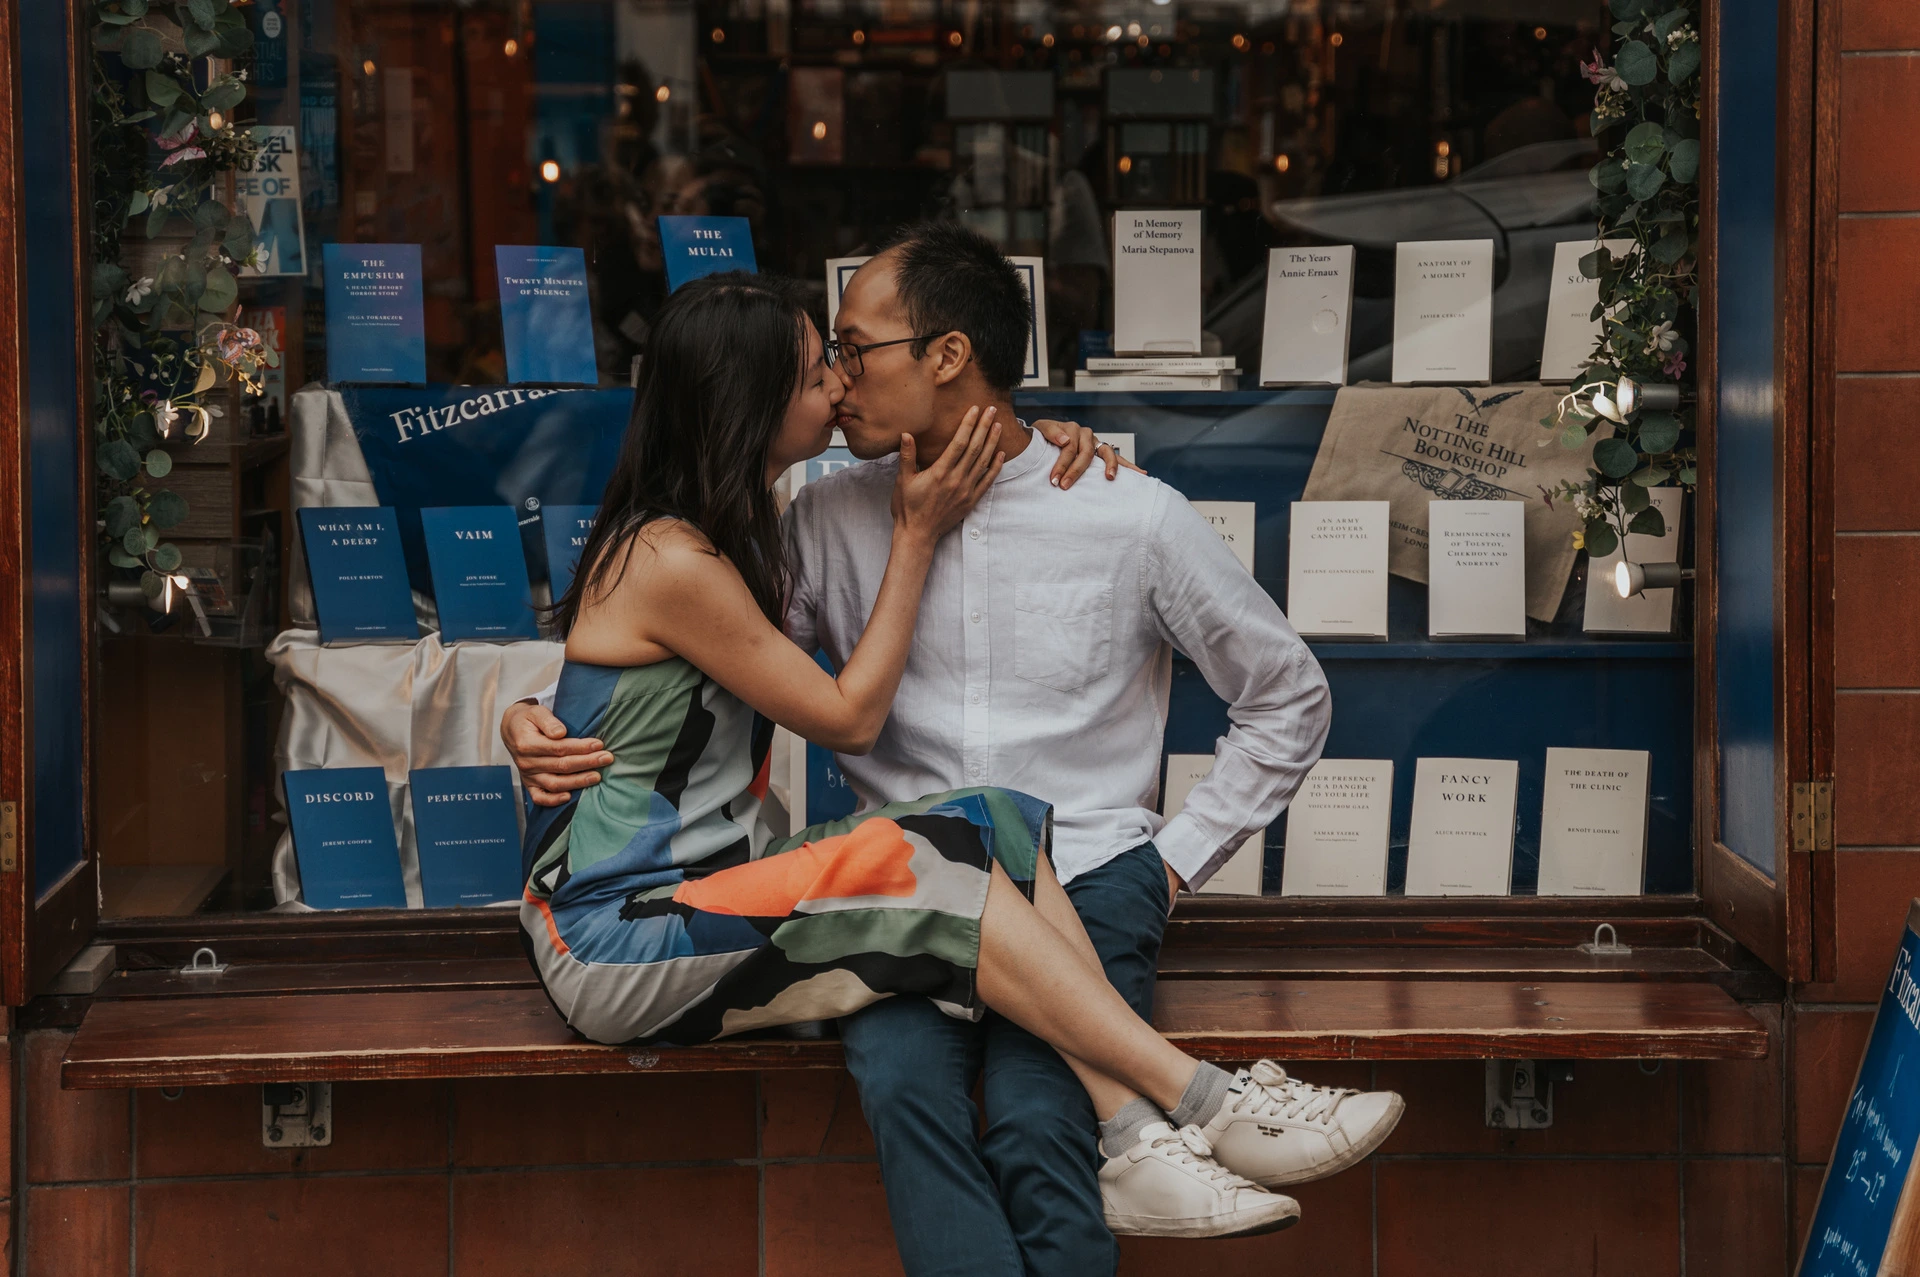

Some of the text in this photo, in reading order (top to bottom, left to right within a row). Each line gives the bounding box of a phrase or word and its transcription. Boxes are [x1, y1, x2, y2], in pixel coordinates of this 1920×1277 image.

[262, 177, 290, 196] OF
[1134, 219, 1183, 229] In Memory
[693, 230, 722, 239] THE
[1133, 230, 1183, 240] of Memory
[1122, 245, 1195, 256] Maria Stepanova
[362, 259, 385, 267] THE
[1289, 254, 1331, 263] The Years
[343, 272, 405, 280] EMPUSIUM
[1280, 268, 1339, 278] Annie Ernaux
[1455, 413, 1490, 438] THE
[1402, 416, 1528, 469] NOTTING HILL
[1413, 438, 1507, 479] BOOKSHOP
[455, 530, 493, 540] VAIM
[342, 538, 377, 546] DEER?
[1404, 537, 1429, 550] LOND
[1441, 774, 1491, 784] FANCY
[1585, 770, 1614, 778] DEATH
[305, 792, 374, 804] DISCORD
[427, 792, 502, 803] PERFECTION
[1442, 793, 1487, 803] WORK
